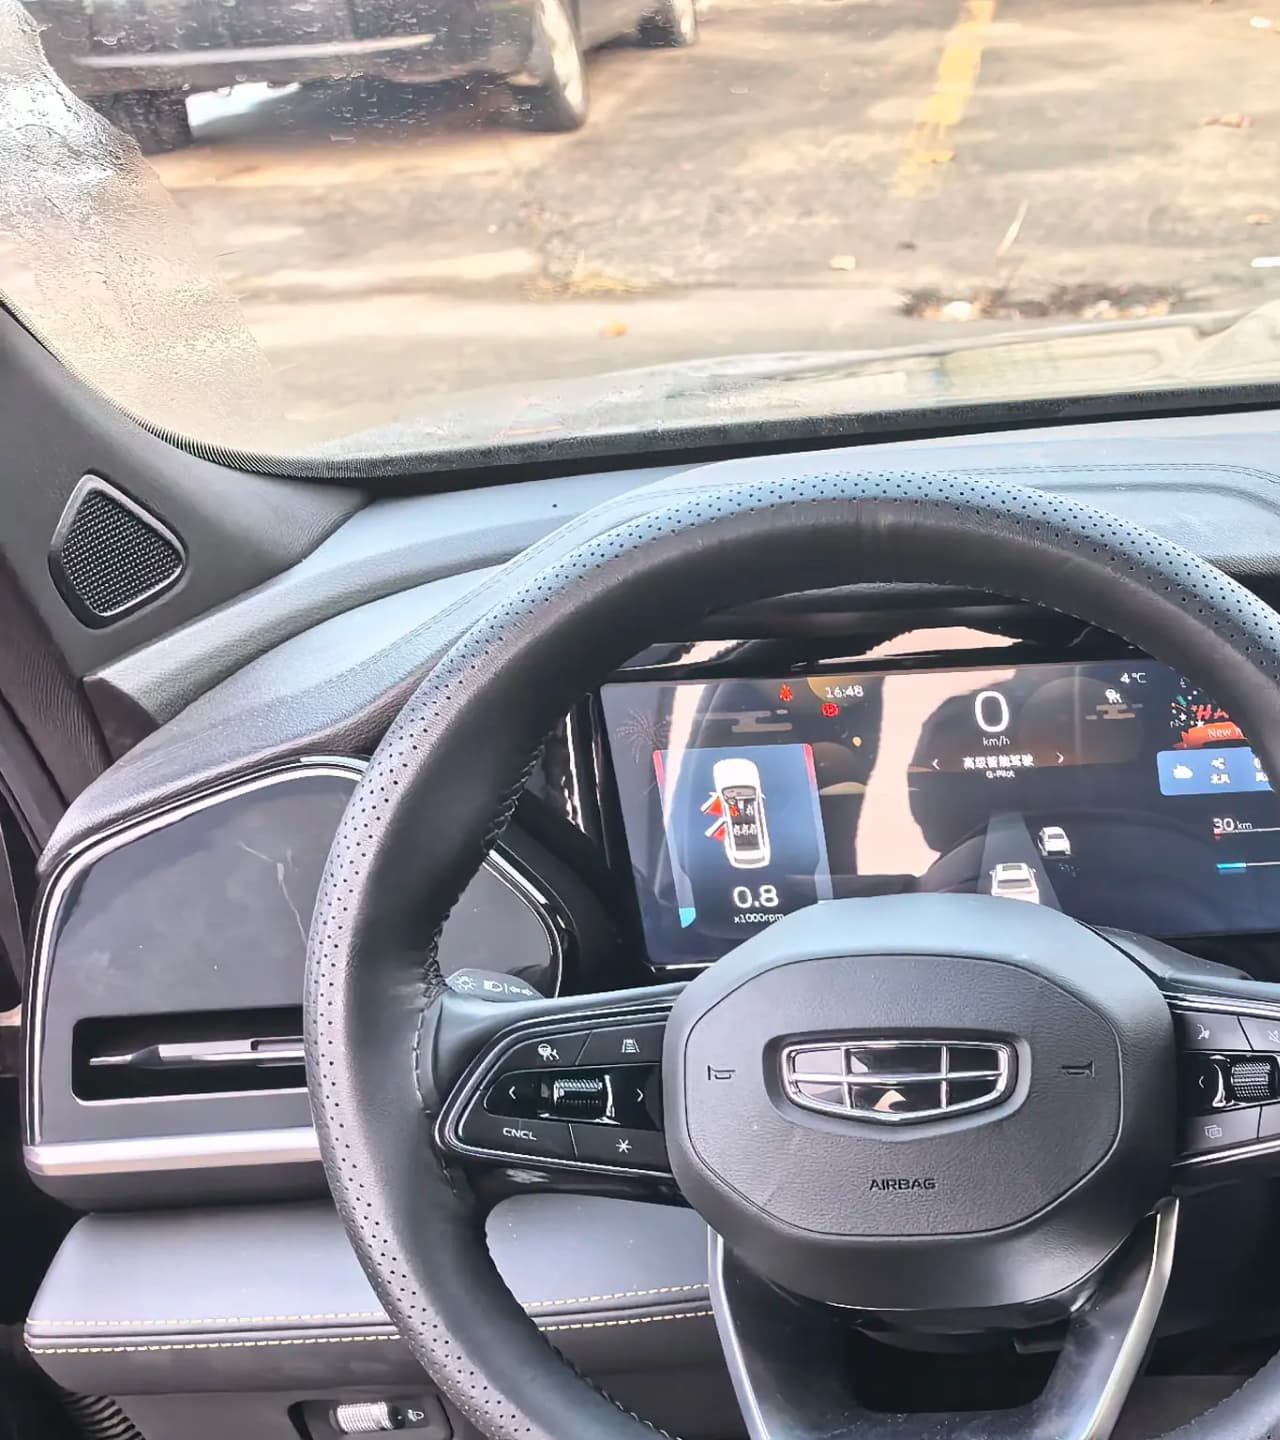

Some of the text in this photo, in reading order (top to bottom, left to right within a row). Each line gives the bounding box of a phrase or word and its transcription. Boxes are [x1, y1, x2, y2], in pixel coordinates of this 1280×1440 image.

[825, 685, 864, 698] 16:48
[975, 690, 1010, 732] 0
[982, 736, 1011, 746] km/h
[1213, 818, 1253, 832] 30 km
[733, 884, 780, 909] 0.8
[503, 1127, 537, 1141] CNCL
[869, 1178, 937, 1191] AIRBAG
